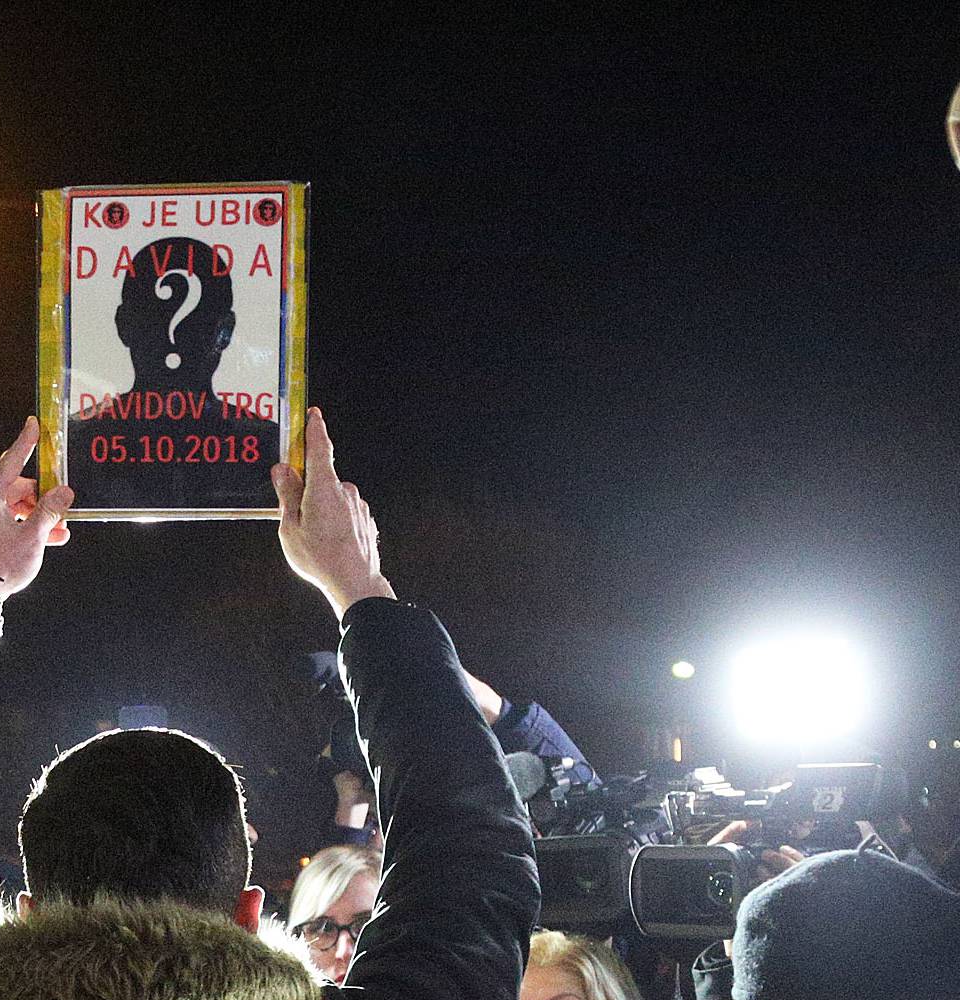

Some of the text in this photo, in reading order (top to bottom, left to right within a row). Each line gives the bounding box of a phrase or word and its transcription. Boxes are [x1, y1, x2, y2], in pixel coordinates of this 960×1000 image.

[142, 200, 177, 228] JE
[76, 244, 273, 280] DAVIDA
[154, 268, 202, 369] ?
[79, 391, 274, 421] DAVIDOV TRG
[90, 434, 261, 464] 05.10.2018
